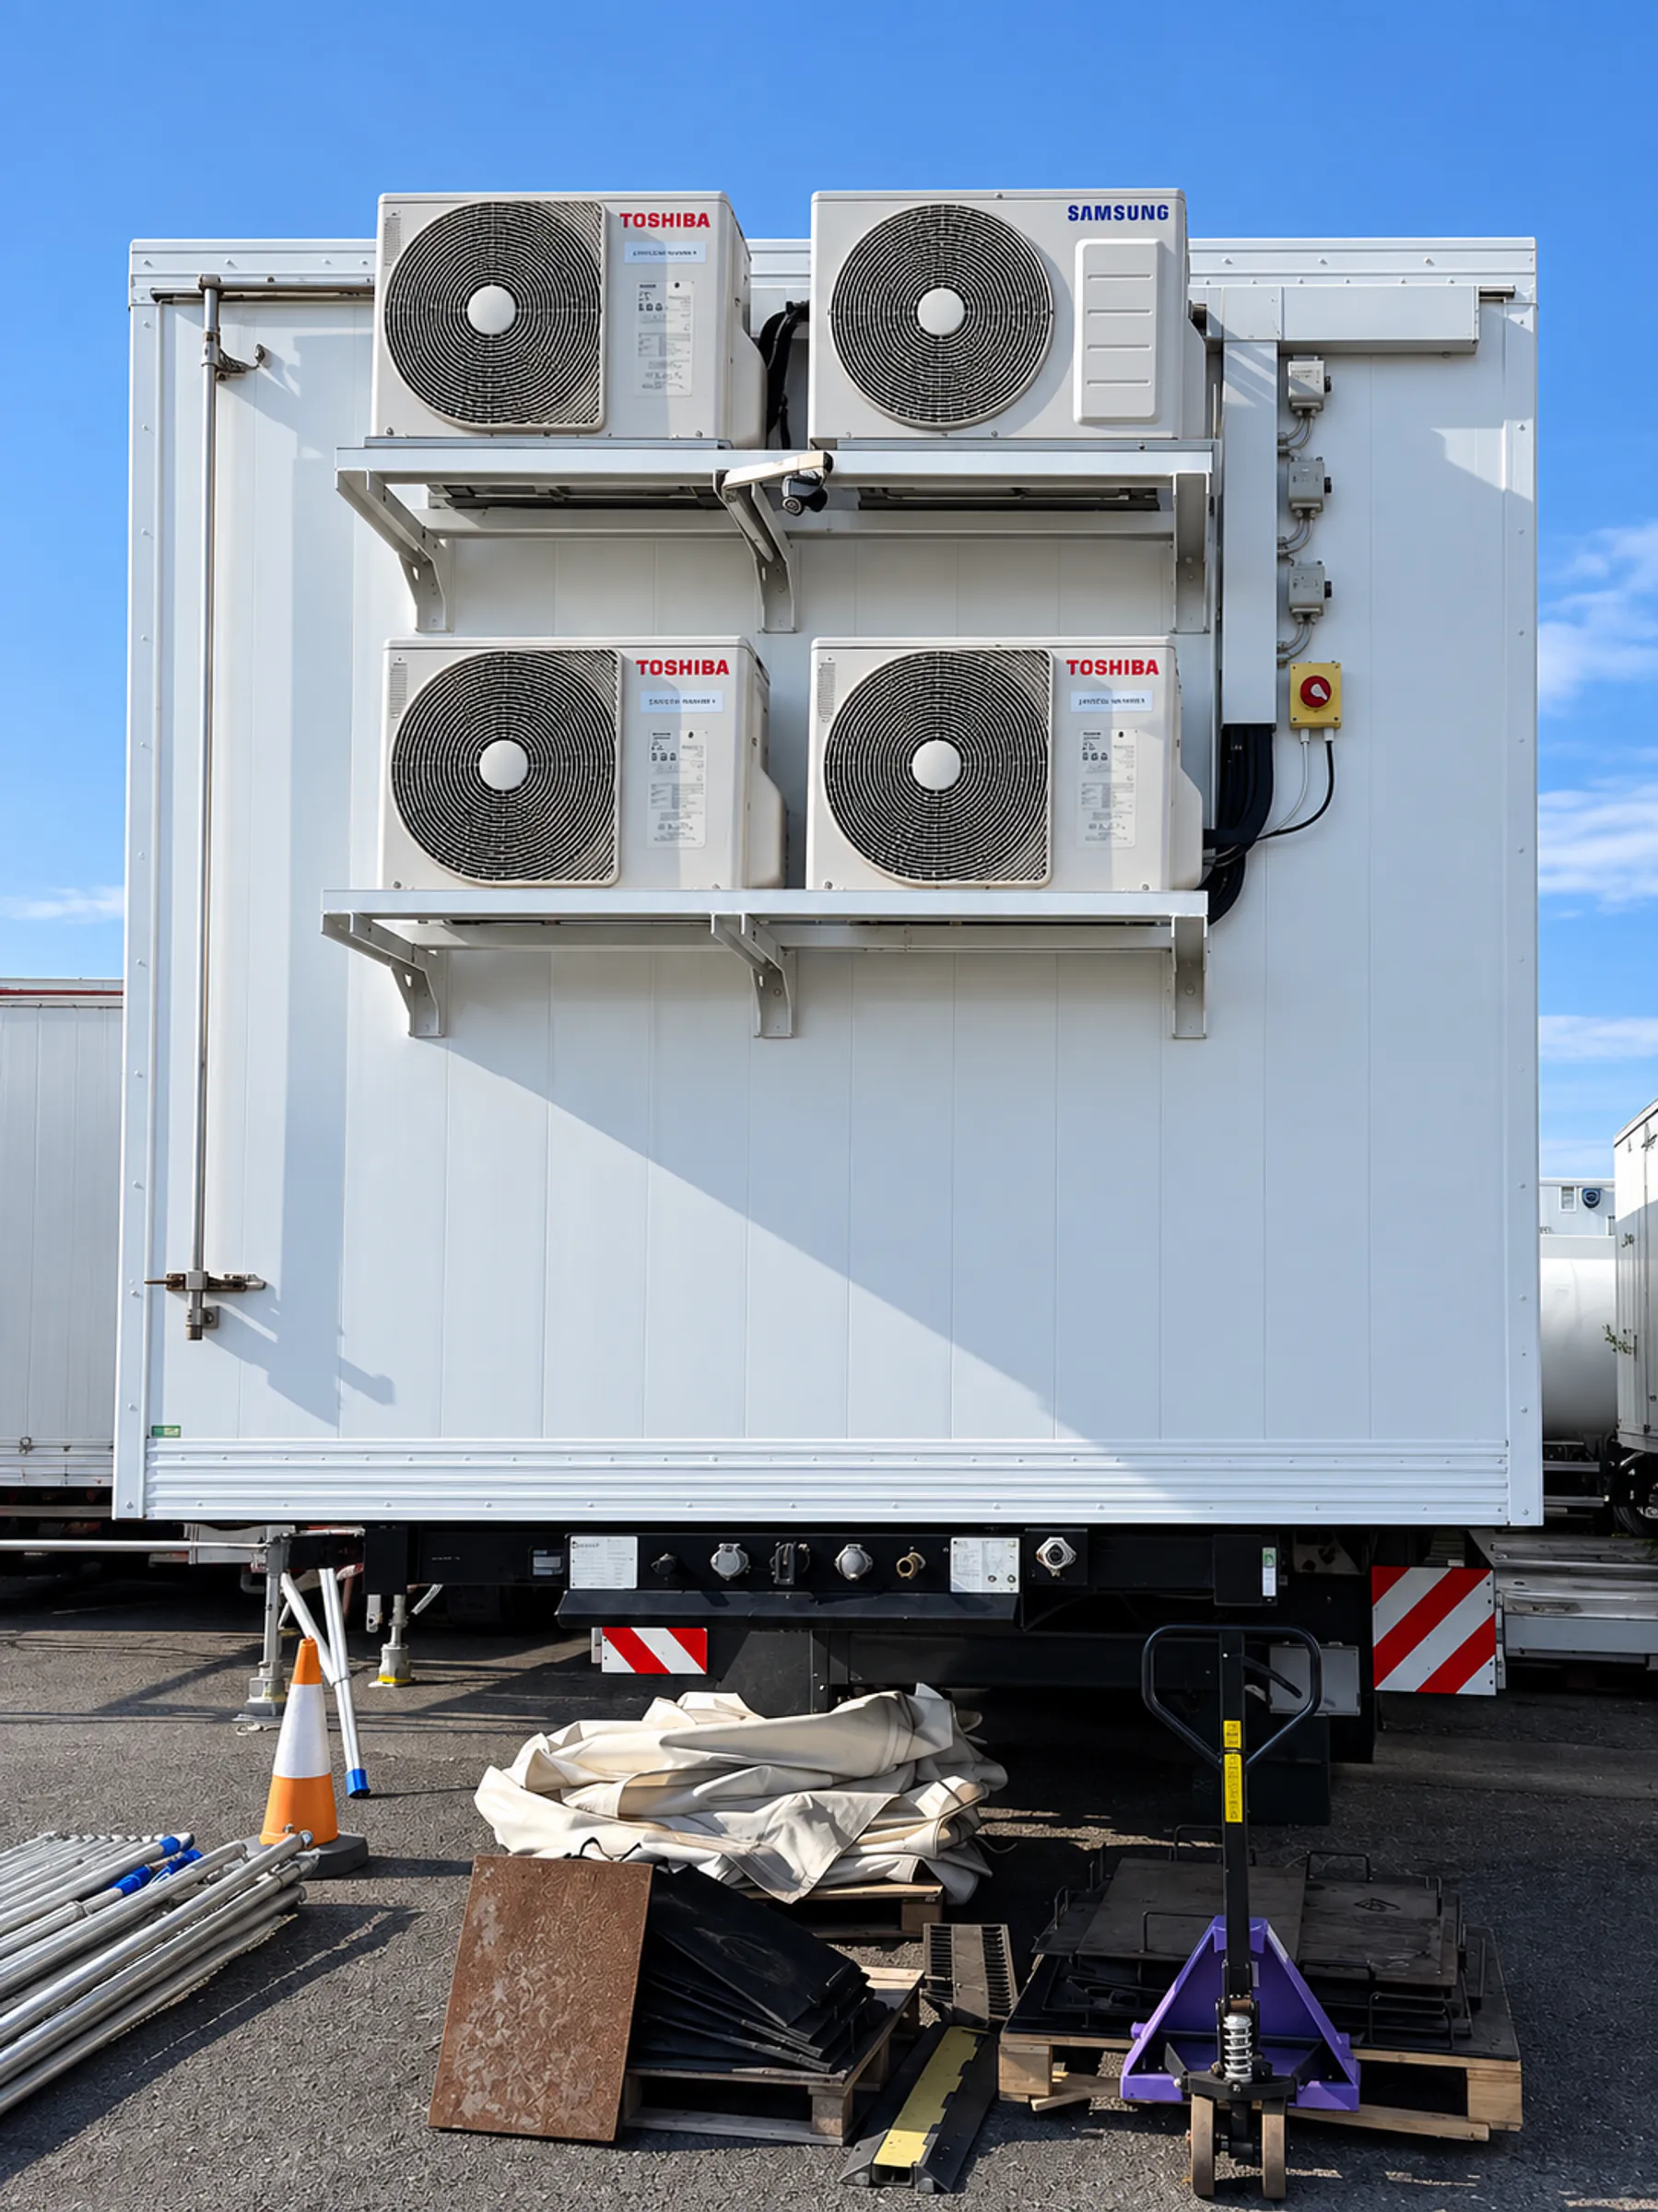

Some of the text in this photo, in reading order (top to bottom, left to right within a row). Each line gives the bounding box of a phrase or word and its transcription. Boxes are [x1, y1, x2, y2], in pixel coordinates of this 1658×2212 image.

[619, 213, 711, 229] TOSHIBA
[1067, 205, 1170, 221] SAMSUNG
[636, 659, 730, 676] TOSHIBA
[1065, 659, 1159, 676] TOSHIBA
